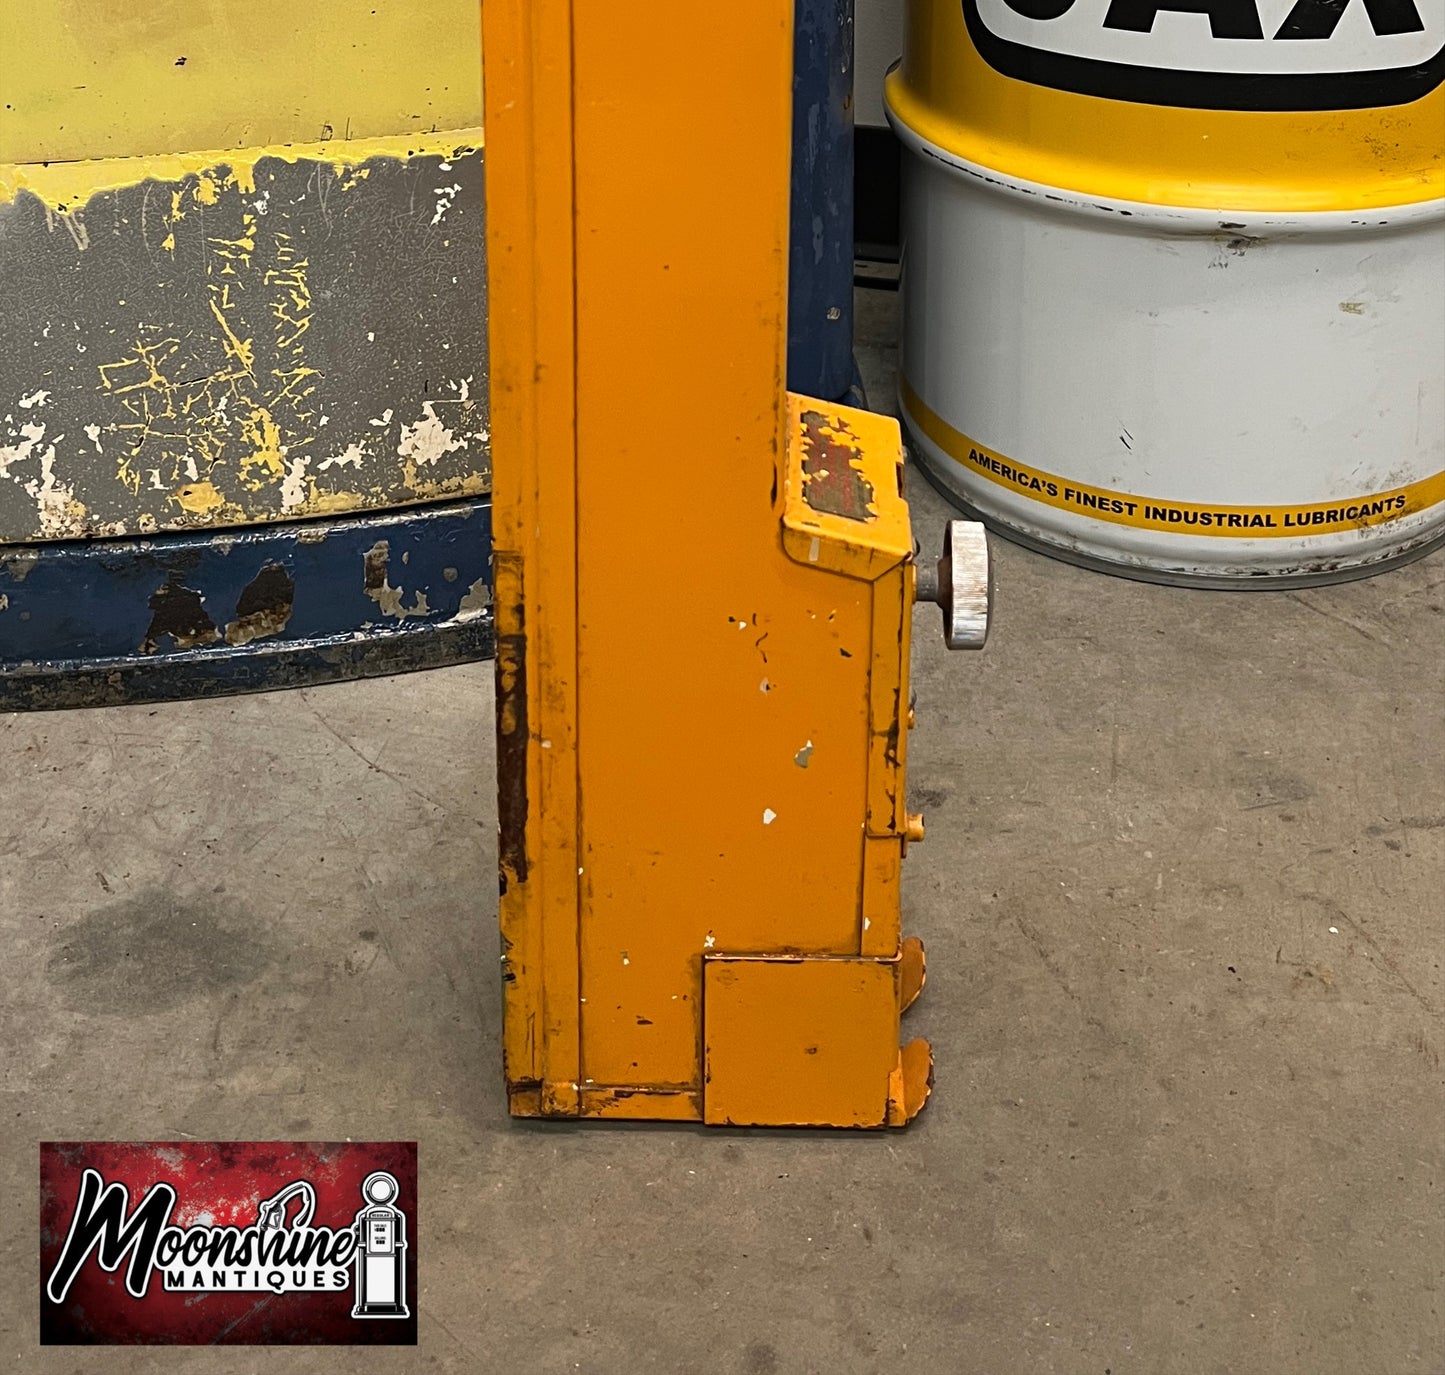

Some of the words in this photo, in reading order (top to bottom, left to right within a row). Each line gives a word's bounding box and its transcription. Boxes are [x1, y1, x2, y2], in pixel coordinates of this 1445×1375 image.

[1064, 489, 1138, 517] FINEST
[1144, 505, 1278, 528] INDUSTRIAL
[1283, 495, 1406, 526] LUBRICANTS
